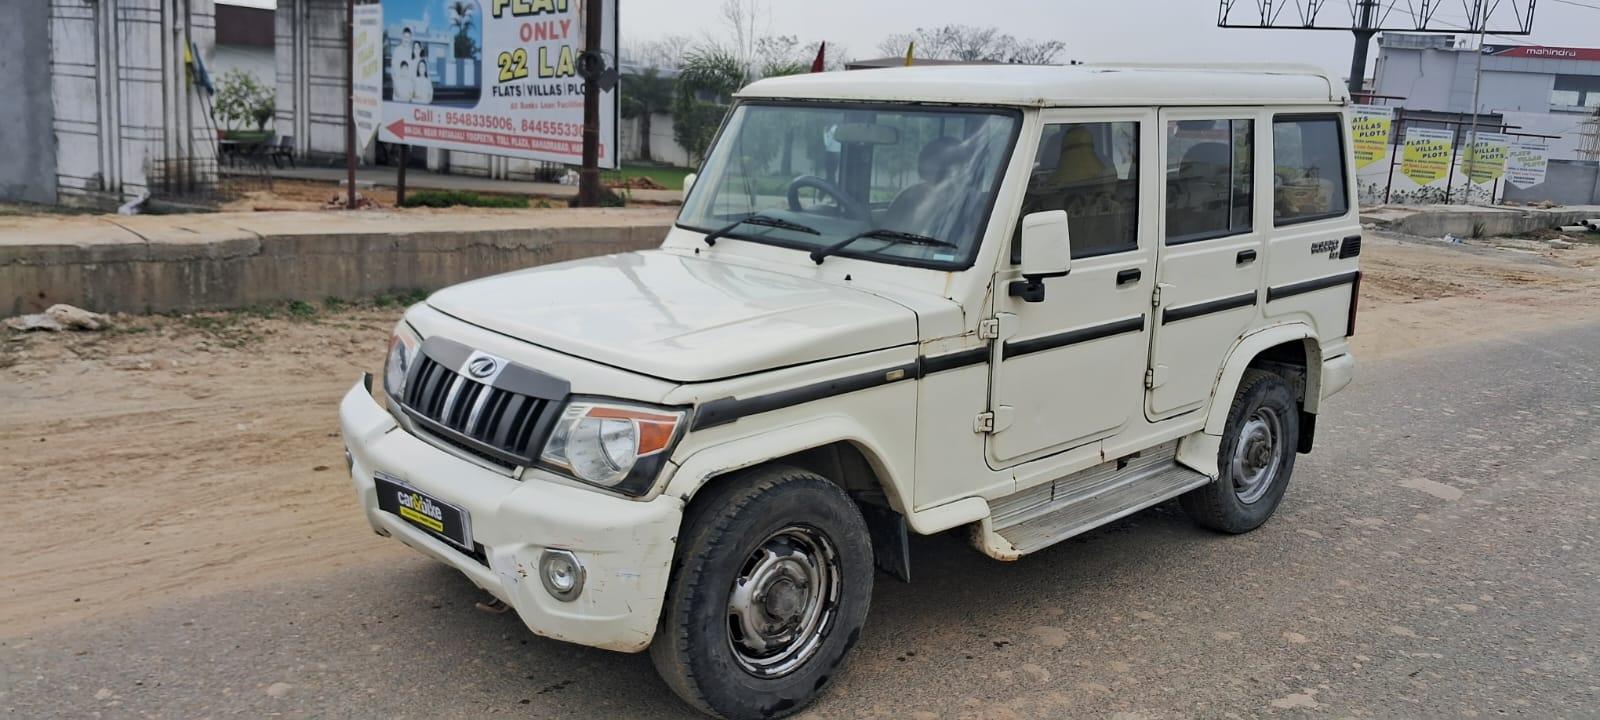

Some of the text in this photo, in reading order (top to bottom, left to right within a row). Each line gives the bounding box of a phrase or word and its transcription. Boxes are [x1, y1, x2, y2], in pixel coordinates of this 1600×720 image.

[520, 19, 571, 42] ONLY
[1526, 47, 1576, 57] mahindra
[498, 45, 580, 83] 22 LA
[492, 85, 522, 97] FLATS
[527, 84, 562, 97] VILLAS
[414, 108, 433, 123] Call
[1359, 130, 1387, 138] PLOTS
[1422, 151, 1448, 159] PLOTS
[397, 491, 443, 520] car&bike
